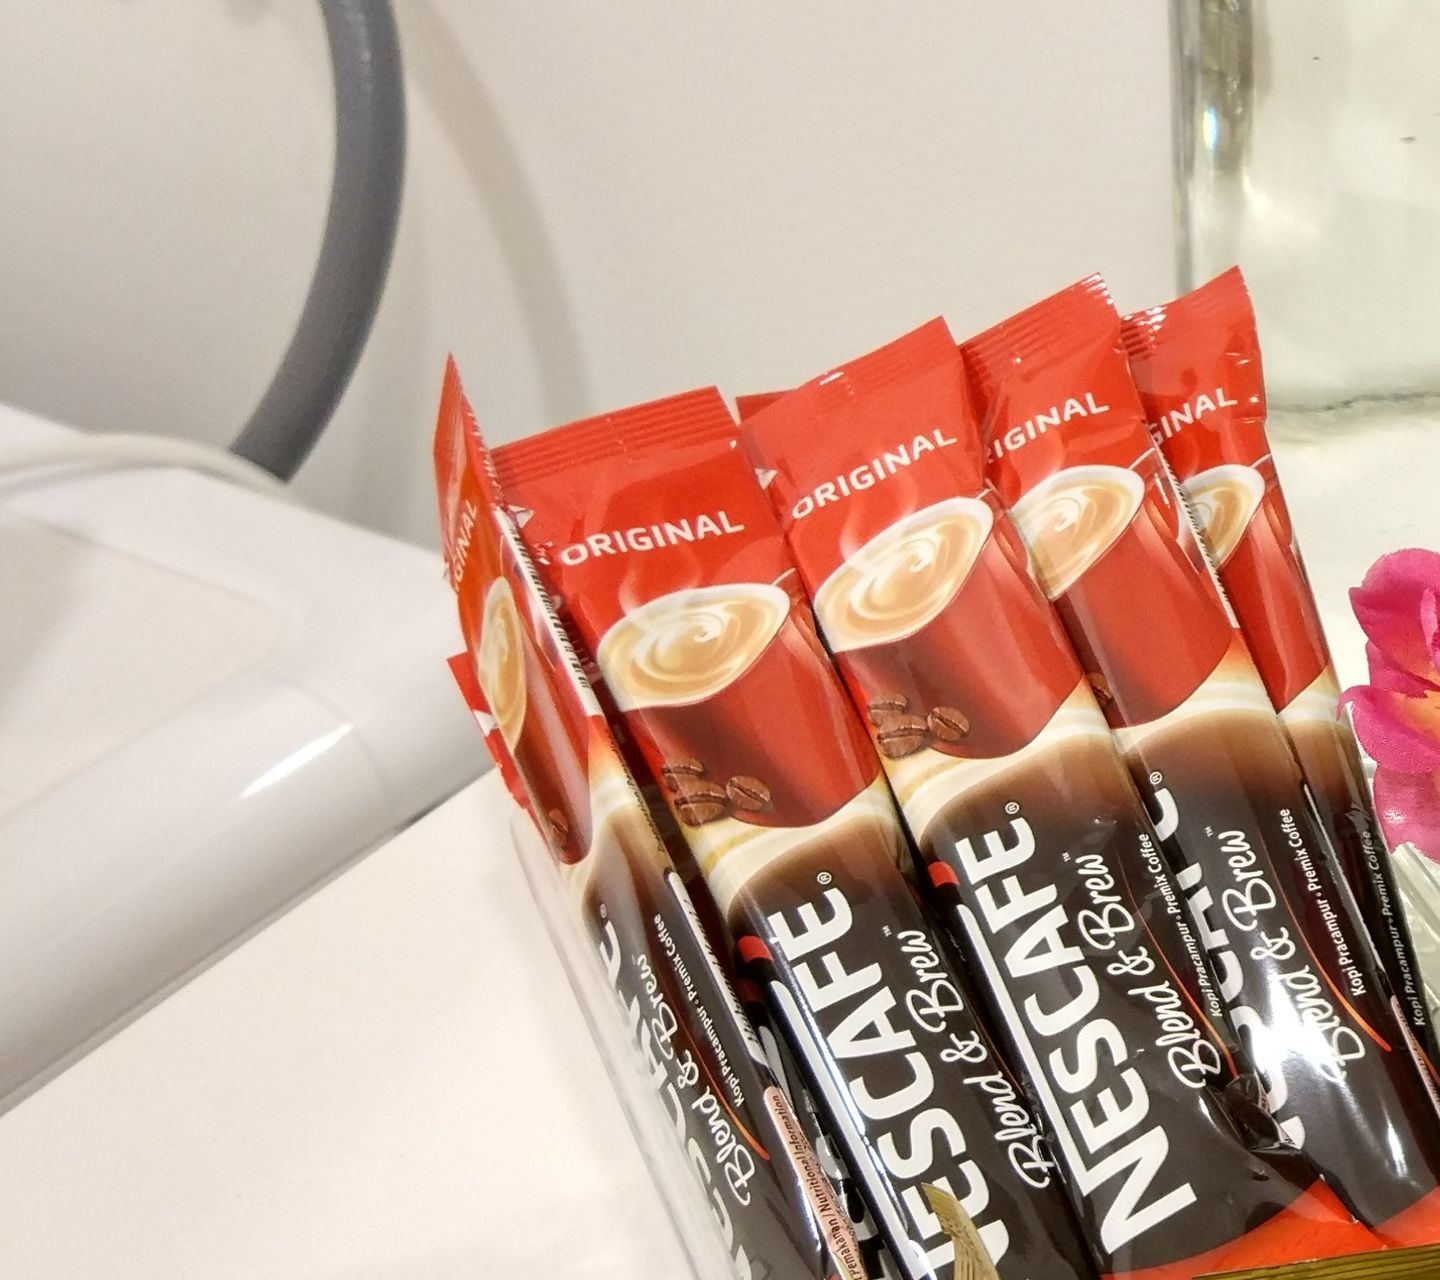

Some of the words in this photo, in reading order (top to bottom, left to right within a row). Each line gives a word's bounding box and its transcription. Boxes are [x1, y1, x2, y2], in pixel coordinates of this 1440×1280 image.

[986, 392, 1110, 464] IGINAL
[1149, 387, 1238, 447] GINAL
[792, 427, 957, 519] ORIGINAL
[560, 509, 745, 568] ORIGINAL
[1139, 833, 1163, 873] Coffee
[1280, 808, 1303, 849] Coffee
[1362, 831, 1379, 870] Coffee
[1153, 874, 1178, 915] Premix
[1218, 830, 1276, 931] Brew
[1295, 852, 1322, 892] Premix
[1373, 873, 1393, 917] Premix
[1075, 854, 1135, 950] Brew
[654, 913, 676, 955] Coffee
[1107, 945, 1155, 975] &
[1176, 920, 1212, 987] Pracampur
[1250, 926, 1297, 960] &
[1317, 899, 1350, 967] Pracampur
[1389, 925, 1416, 995] Pracampur
[638, 954, 678, 1060] Brew
[674, 956, 698, 1001] Premix
[897, 929, 963, 1033] Brew
[1202, 987, 1223, 1017] Kopi
[1347, 968, 1367, 996] Kopi
[697, 1006, 733, 1073] Pracampur
[1128, 981, 1221, 1088] Blend
[1409, 996, 1426, 1026] Kopi
[677, 1050, 699, 1088] &
[940, 1030, 987, 1063] &
[725, 1074, 745, 1106] Kopi
[692, 1086, 754, 1206] Blend
[772, 1094, 802, 1155] Information
[963, 1071, 1053, 1189] Blend
[799, 1156, 832, 1213] Nutritional
